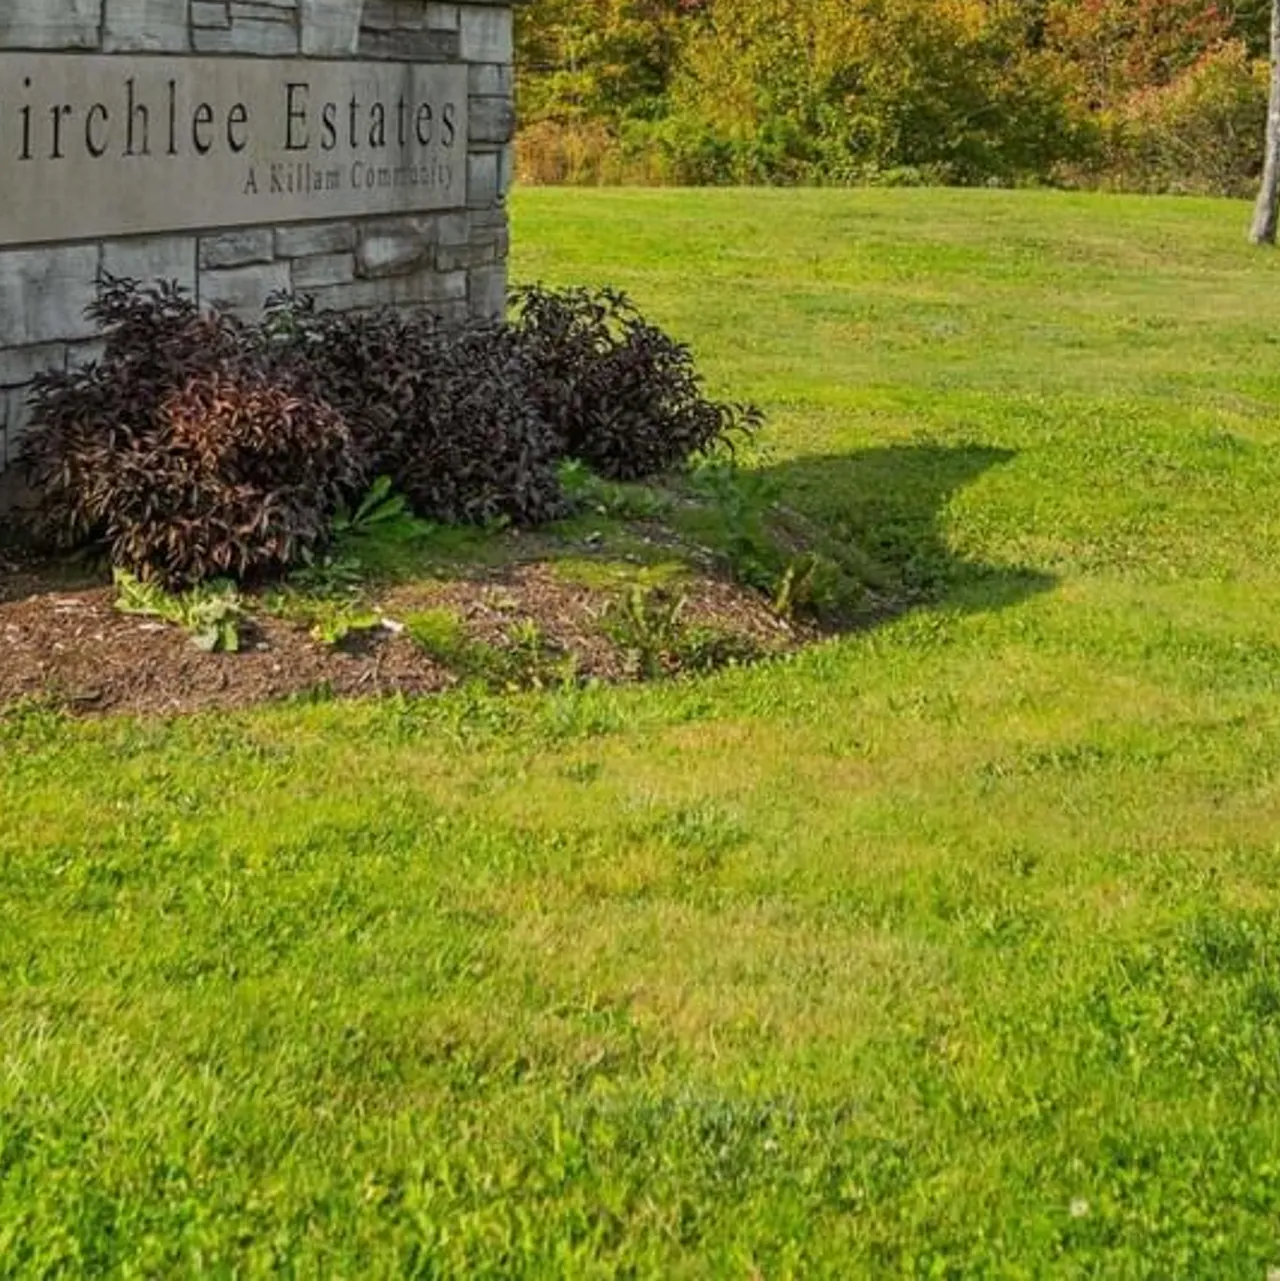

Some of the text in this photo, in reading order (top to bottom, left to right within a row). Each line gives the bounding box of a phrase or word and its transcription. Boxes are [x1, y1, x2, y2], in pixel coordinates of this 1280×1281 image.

[284, 82, 456, 152] Estates
[243, 167, 258, 195] A
[269, 161, 341, 195] Killam
